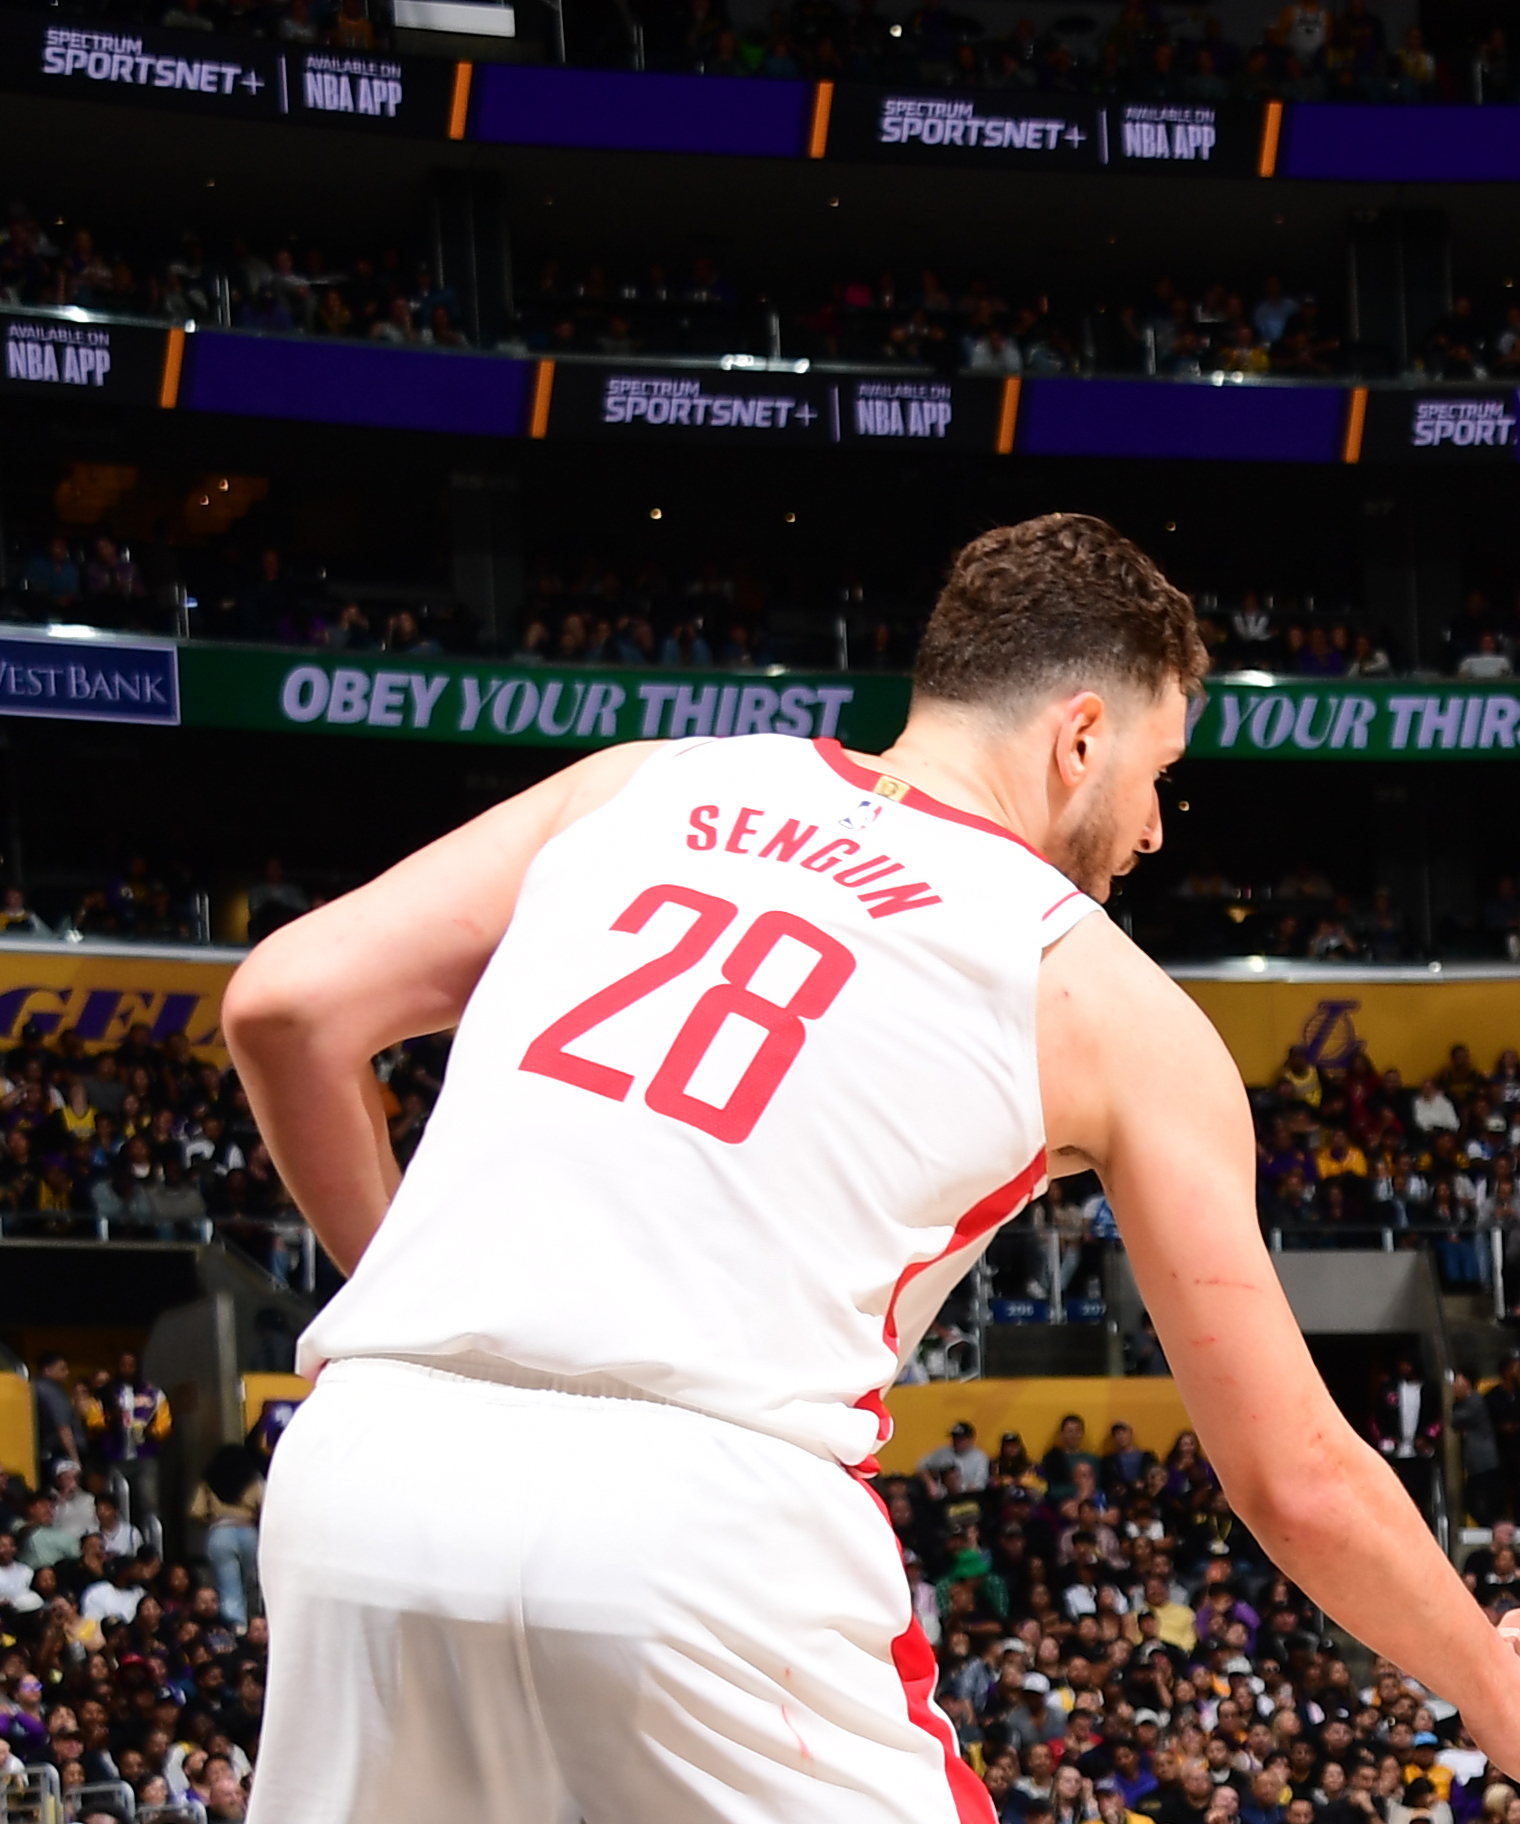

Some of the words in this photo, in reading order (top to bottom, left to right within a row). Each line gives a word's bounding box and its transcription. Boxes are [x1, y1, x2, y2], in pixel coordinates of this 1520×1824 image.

[45, 27, 143, 55] SPECTRUM
[42, 48, 265, 96] SPORTSNET+
[307, 53, 376, 75] AVAILABLE
[380, 60, 401, 77] ON
[304, 73, 356, 113] NBA
[359, 77, 401, 117] APP
[883, 98, 974, 120] SPECTRUM
[1125, 106, 1186, 121] AVAILABLE
[1191, 110, 1215, 122] ON
[879, 111, 1087, 150] SPORTSNET+
[1122, 122, 1169, 159] NBA
[1174, 124, 1216, 160] APP
[9, 325, 83, 345] AVAILABLE
[87, 330, 110, 346] ON
[7, 339, 58, 383] NBA
[65, 346, 111, 387] APP
[608, 378, 700, 398] SPECTRUM
[859, 383, 923, 399] AVAILABLE
[927, 386, 951, 399] ON
[605, 394, 818, 429] SPORTSNET+
[856, 398, 904, 436] NBA
[909, 401, 952, 437] APP
[1417, 402, 1505, 422] SPECTRUM
[1413, 416, 1510, 446] SPORT
[68, 665, 167, 705] BANK
[283, 667, 450, 727] OBEY
[460, 677, 626, 737] YOUR
[640, 684, 854, 740] THIRST
[1218, 693, 1377, 750] YOUR
[686, 804, 944, 920] SENGUN
[517, 884, 857, 1145] 28
